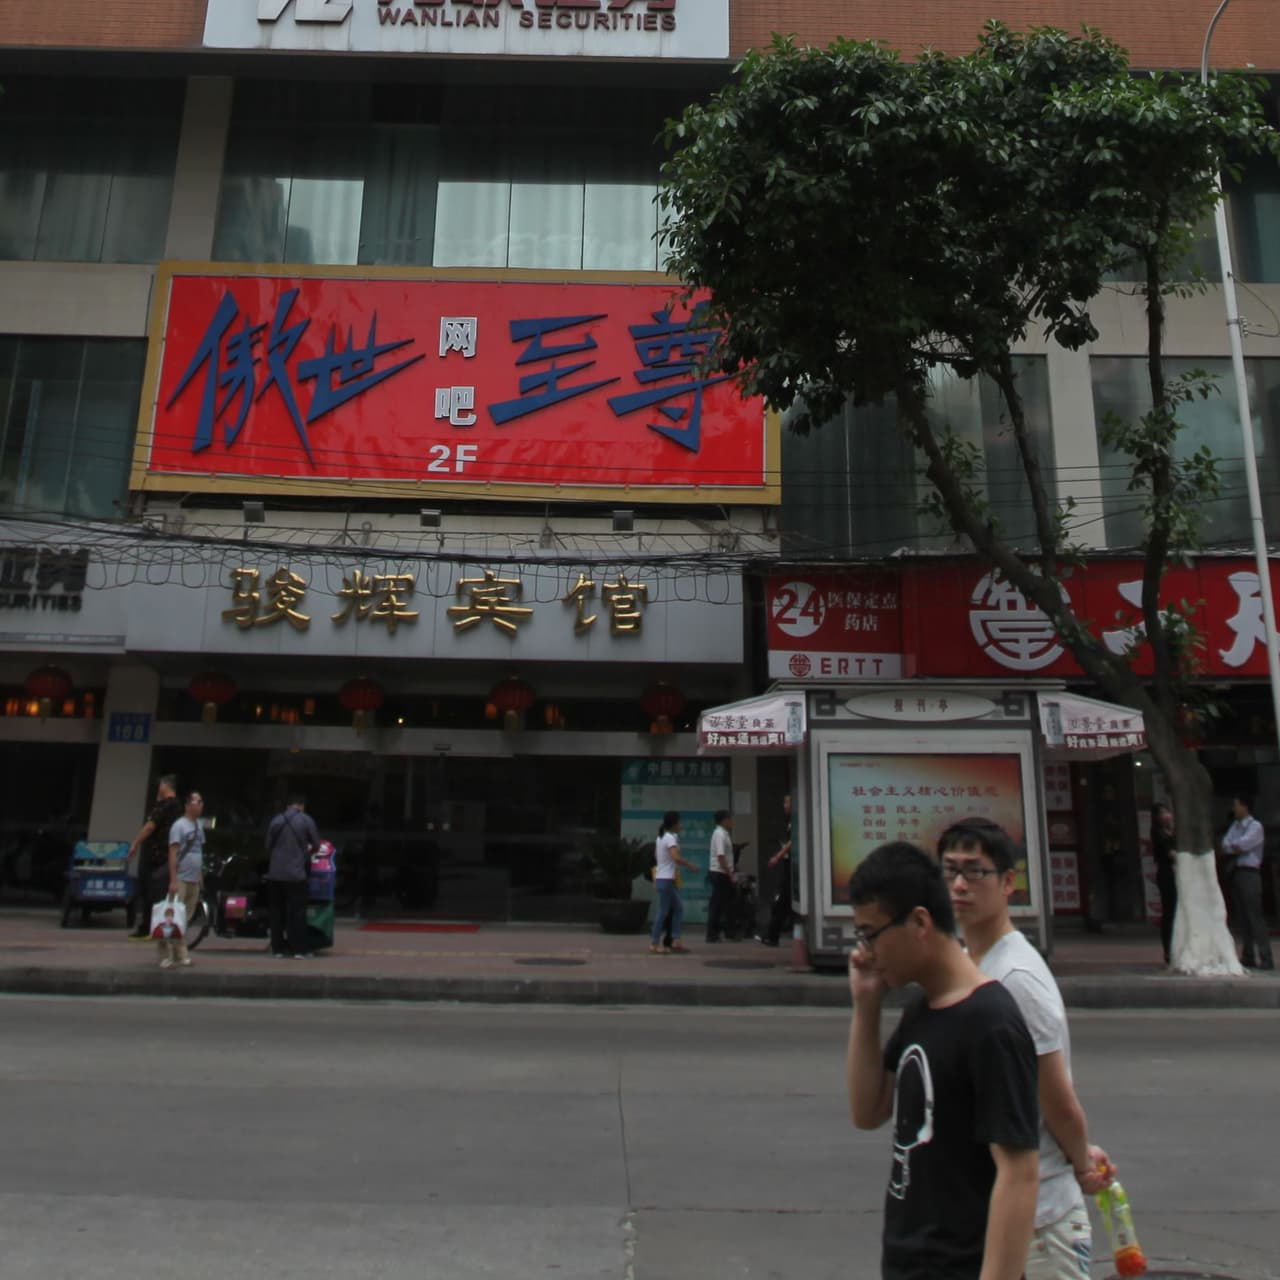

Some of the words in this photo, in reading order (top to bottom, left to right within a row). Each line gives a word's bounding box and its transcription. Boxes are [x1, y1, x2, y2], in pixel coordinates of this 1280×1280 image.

[377, 7, 500, 28] WANLIAN
[520, 8, 677, 32] SECURITIES
[166, 287, 427, 467] 傲世
[488, 300, 734, 454] 至尊
[434, 316, 477, 427] 网吧
[427, 444, 479, 474] 2F
[221, 565, 650, 639] 骏辉宾馆
[774, 587, 825, 626] 24
[827, 591, 898, 609] 医保定点
[843, 612, 880, 632] 药店
[820, 657, 884, 676] ERTT
[851, 784, 1001, 798] 社会主义核心价值观
